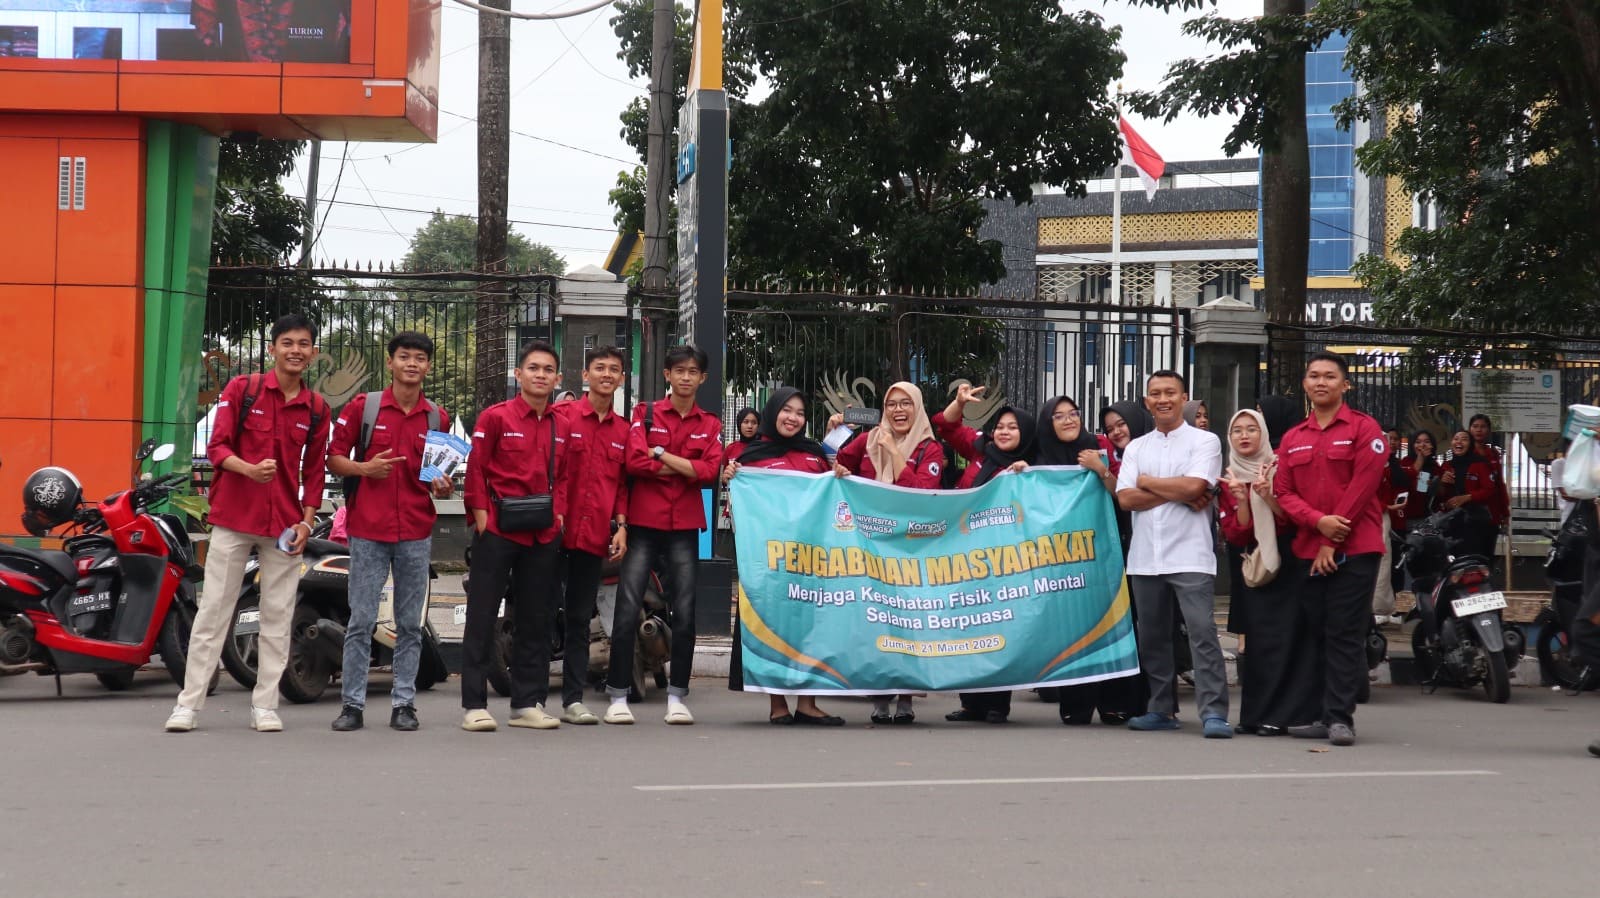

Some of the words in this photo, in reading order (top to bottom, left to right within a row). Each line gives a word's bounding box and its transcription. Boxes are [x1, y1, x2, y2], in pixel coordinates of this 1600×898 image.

[288, 27, 324, 35] TURION
[970, 518, 989, 530] BAIK
[990, 514, 1016, 526] SEKALI
[925, 529, 1095, 586] MASYARAKAT
[98, 591, 111, 601] HX
[788, 583, 855, 606] Menjaga
[861, 586, 944, 610] Kesehatan
[949, 588, 992, 608] Fisik
[997, 585, 1029, 601] dan
[1034, 573, 1086, 593] Mental
[866, 607, 922, 629] Selama
[928, 608, 1013, 630] Berpuasa
[920, 643, 934, 654] 21
[937, 642, 969, 653] Maret
[972, 637, 1000, 650] 2025
